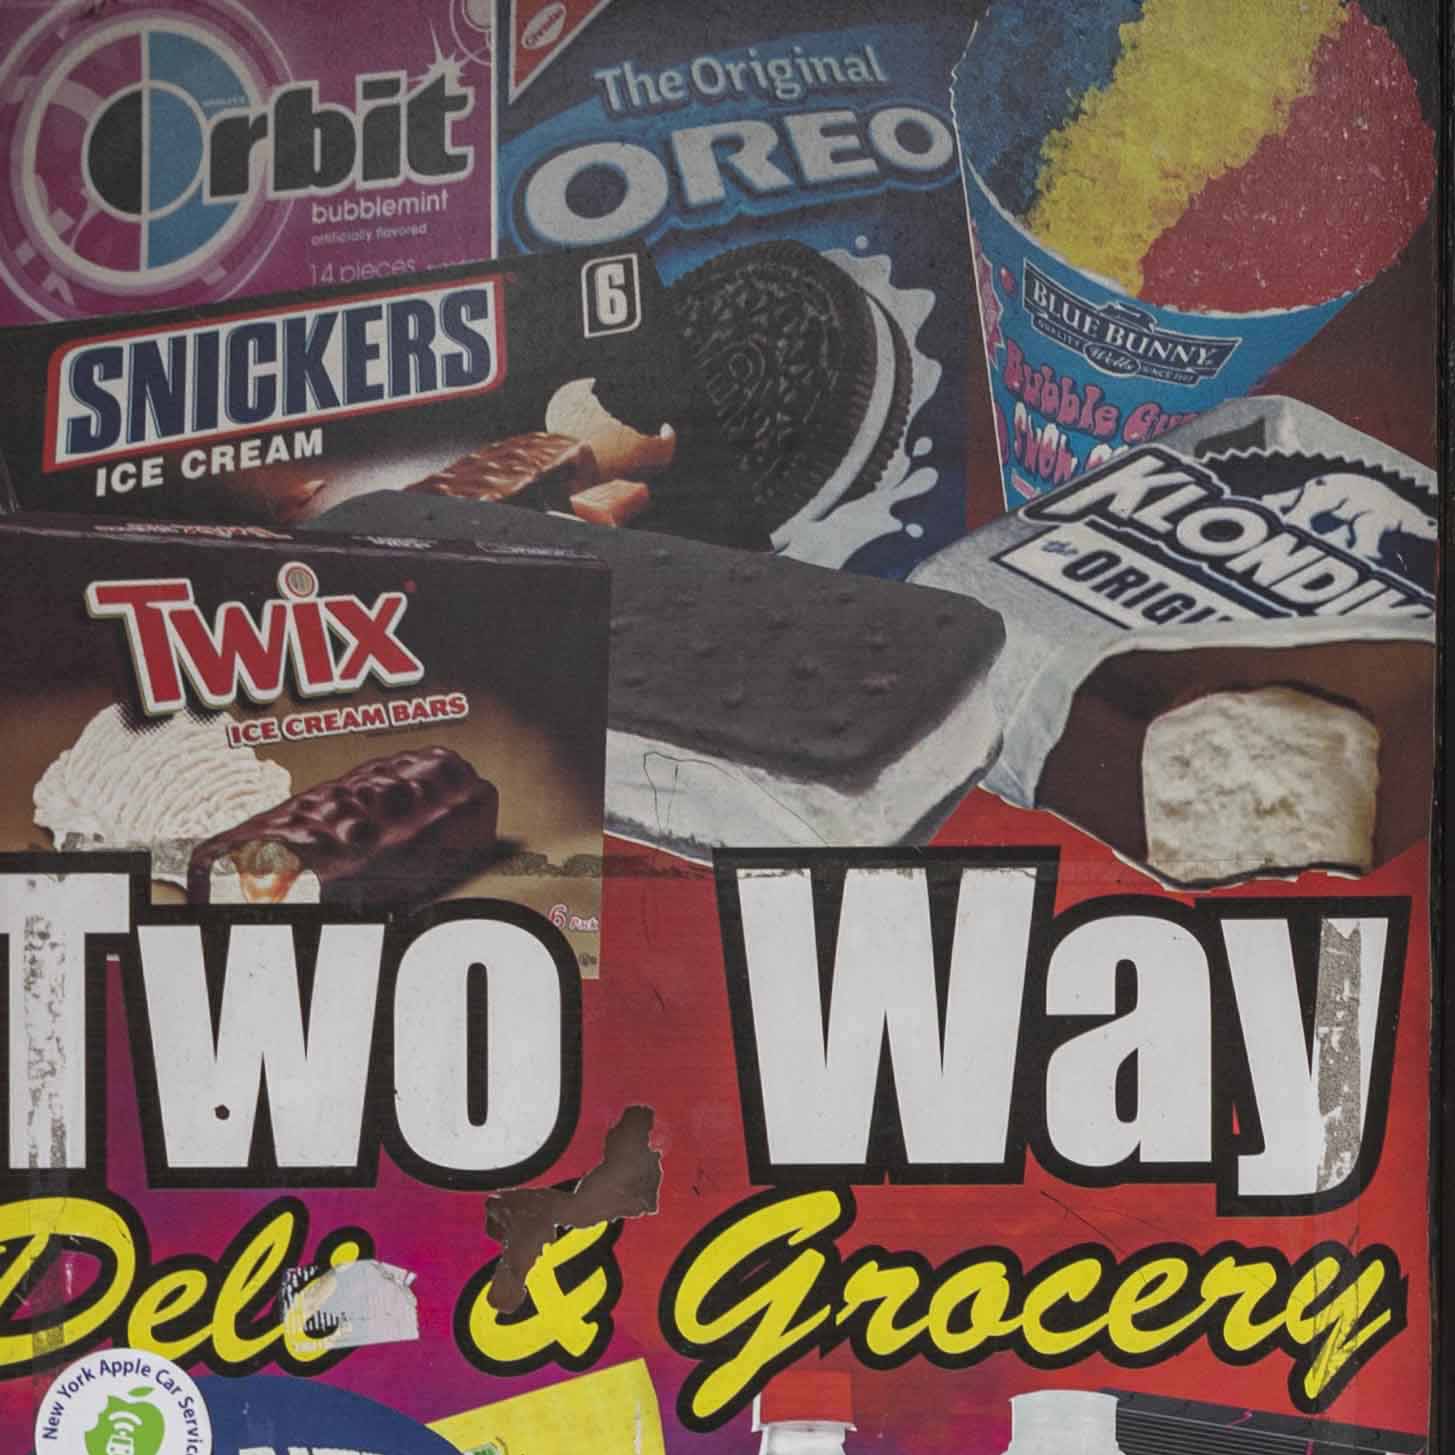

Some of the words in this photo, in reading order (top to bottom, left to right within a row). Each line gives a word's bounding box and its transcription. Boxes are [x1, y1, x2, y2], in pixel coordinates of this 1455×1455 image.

[595, 67, 683, 112] The
[691, 47, 888, 98] Original
[82, 66, 476, 222] Orbit
[525, 108, 955, 246] OREO
[310, 190, 449, 224] bubblemint
[593, 263, 627, 327] 6
[1031, 278, 1101, 338] BLUE
[1104, 323, 1217, 367] BUNNY
[66, 288, 492, 456] SNICKERS
[1005, 341, 1119, 443] Bubble
[95, 462, 164, 498] ICE
[181, 428, 324, 483] CREAM
[85, 560, 425, 715] Twix
[227, 719, 279, 747] ICE
[285, 707, 386, 739] CREAM
[391, 693, 469, 726] BARS
[547, 903, 568, 932] 6
[728, 858, 1396, 1203] Way
[668, 1186, 1396, 1424] Grocery
[42, 1401, 65, 1440] New
[57, 1367, 97, 1400] York
[100, 1357, 152, 1377] Apple
[155, 1368, 183, 1396] Car
